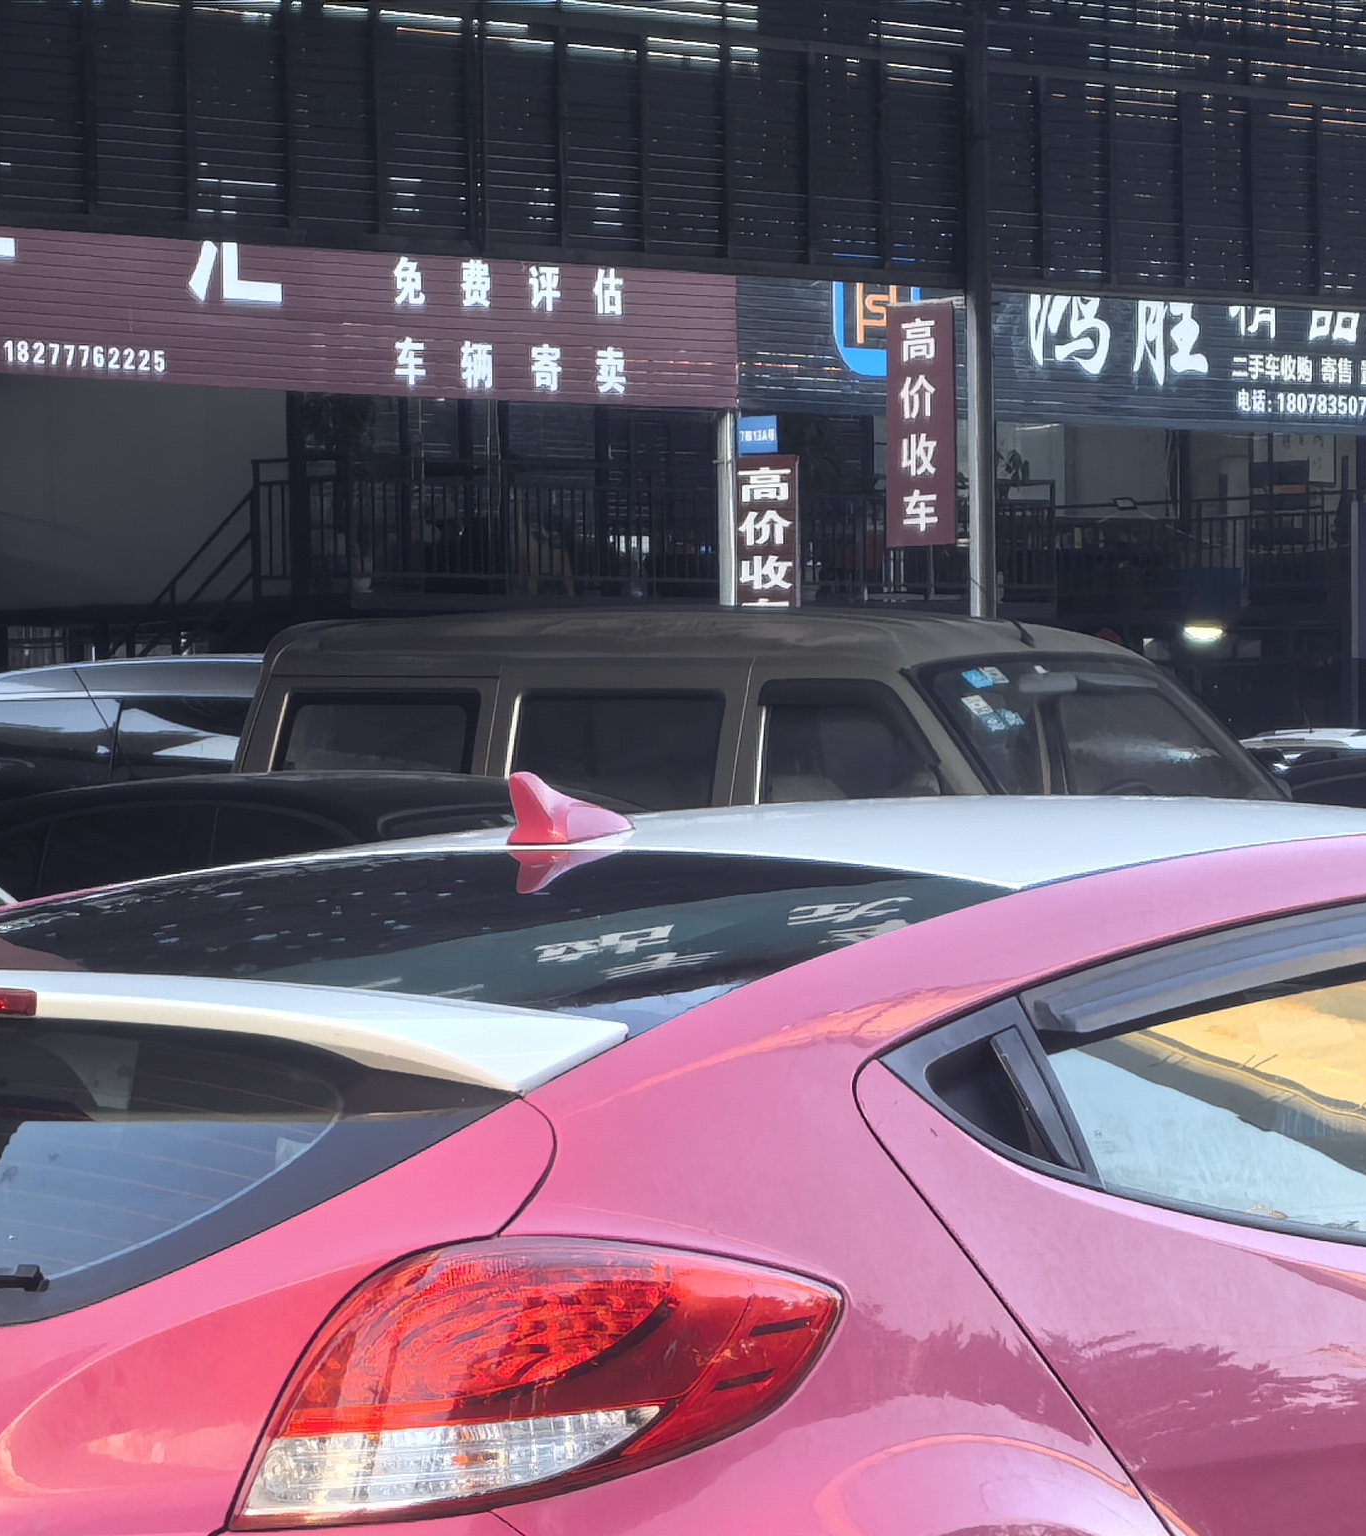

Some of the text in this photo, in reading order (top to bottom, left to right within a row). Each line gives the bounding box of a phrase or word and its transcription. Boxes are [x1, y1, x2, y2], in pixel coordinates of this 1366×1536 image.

[392, 256, 624, 316] 免费评估
[2, 338, 166, 374] 18277762225
[393, 337, 626, 395] 车辆寄卖
[1231, 353, 1313, 383] 二手车收购
[1321, 356, 1353, 386] 寄售
[898, 317, 938, 533] 高价收车
[737, 466, 793, 607] 高价收
